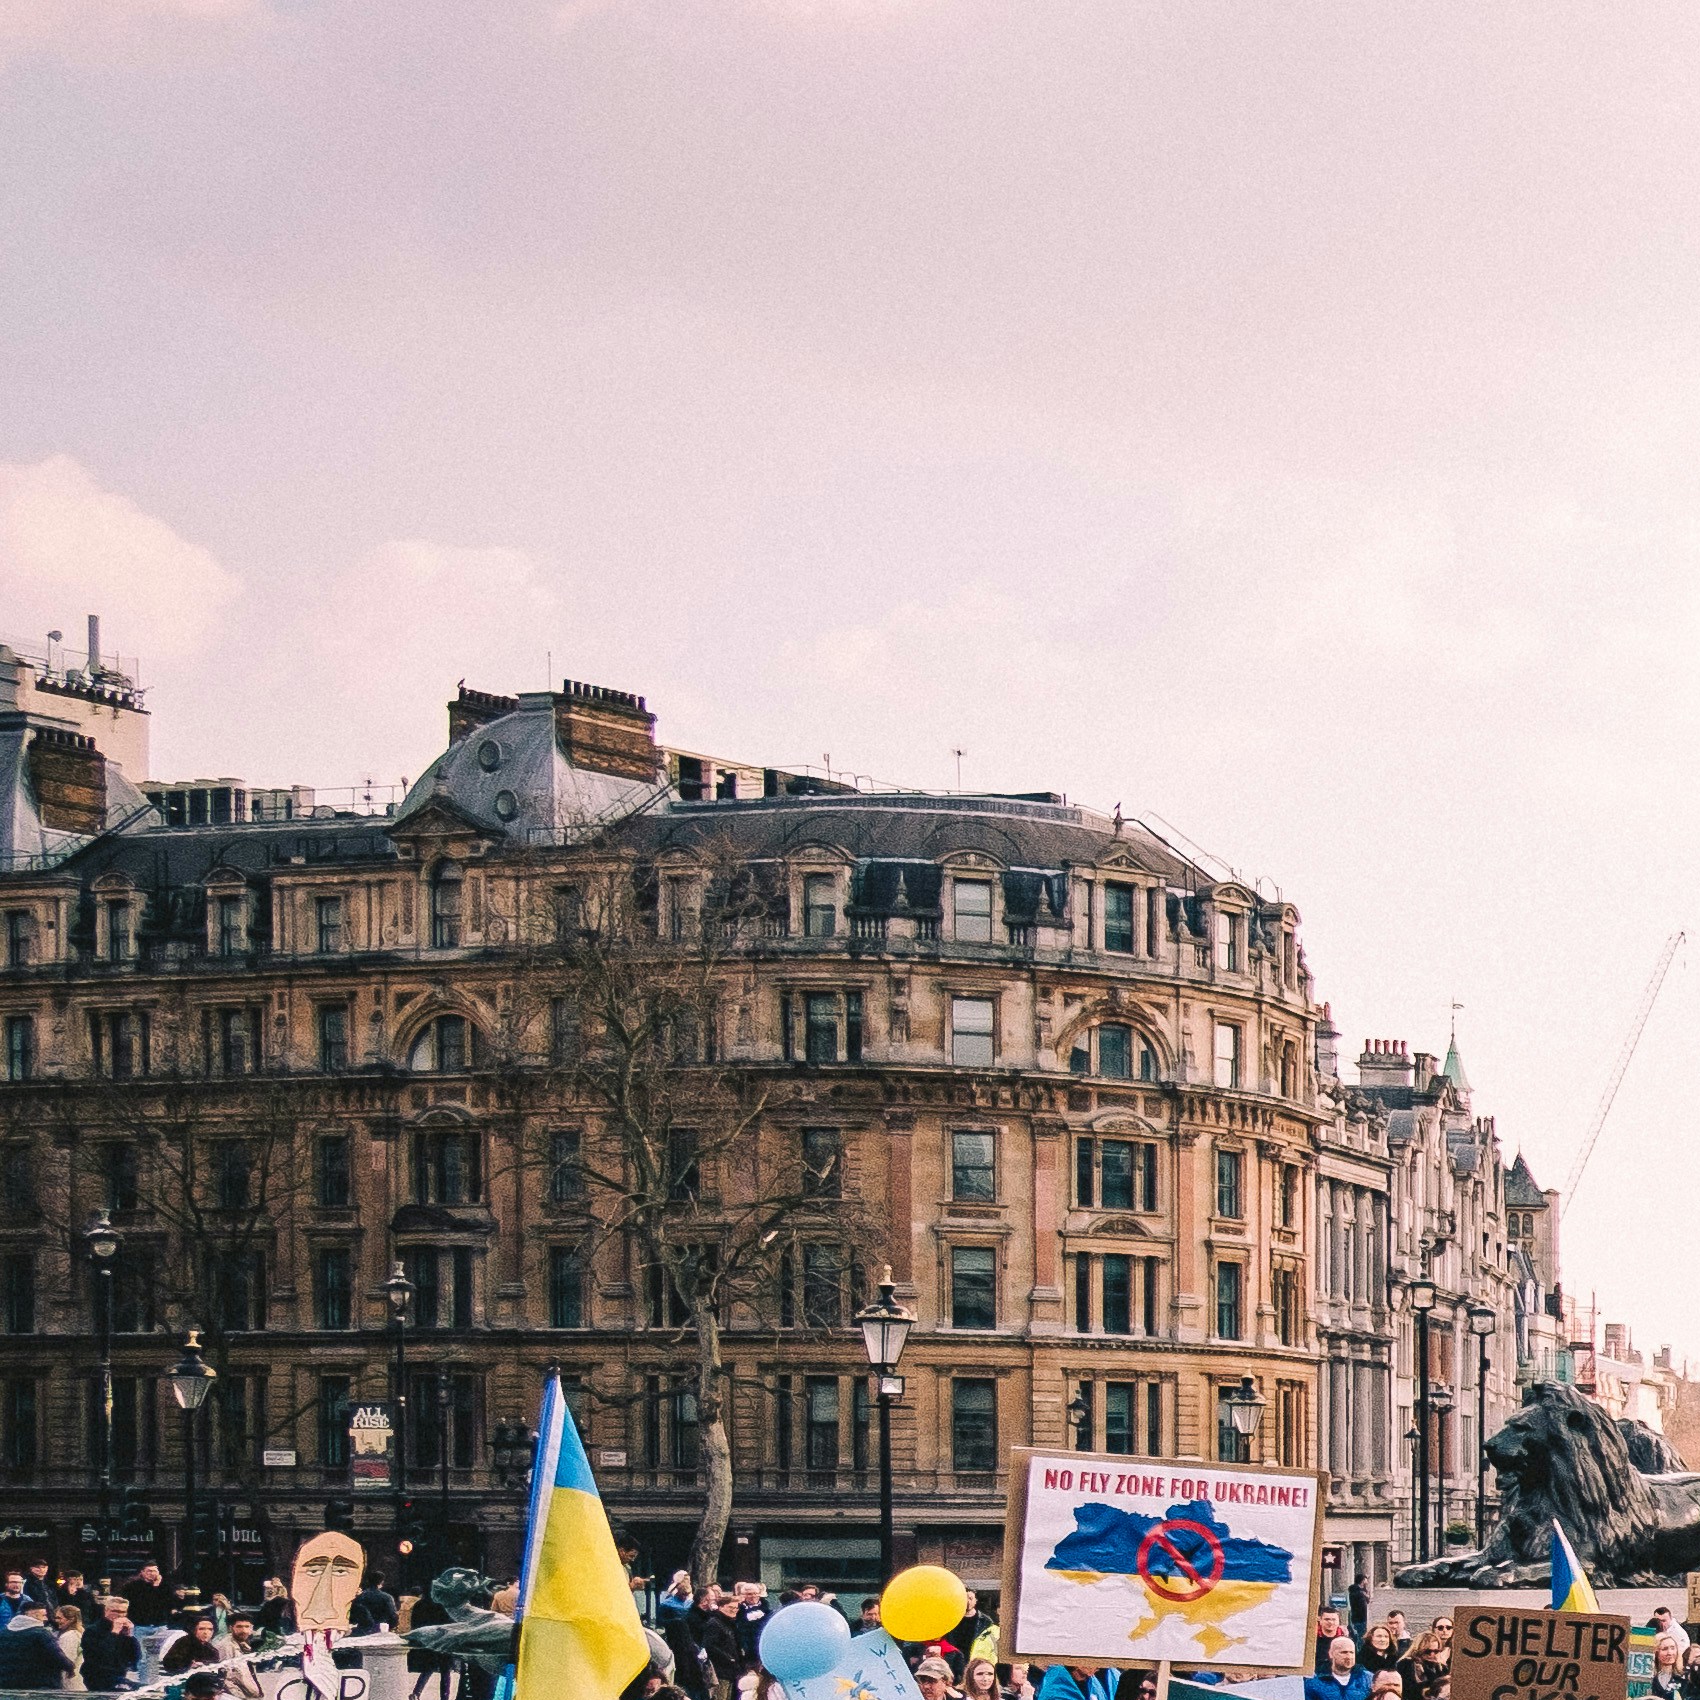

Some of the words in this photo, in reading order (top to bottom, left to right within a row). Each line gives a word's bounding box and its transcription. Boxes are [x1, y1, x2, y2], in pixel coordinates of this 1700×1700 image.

[353, 1417, 390, 1428] RISE
[356, 1407, 386, 1418] ALL
[1044, 1468, 1073, 1491] NO
[1079, 1471, 1111, 1494] FLY
[1115, 1474, 1165, 1498] ZONE
[1170, 1478, 1208, 1502] FOR
[1215, 1481, 1309, 1508] UKRAINE!
[1462, 1614, 1627, 1664] SHELTER
[869, 1643, 907, 1694] WITH
[1512, 1658, 1581, 1692] OUR
